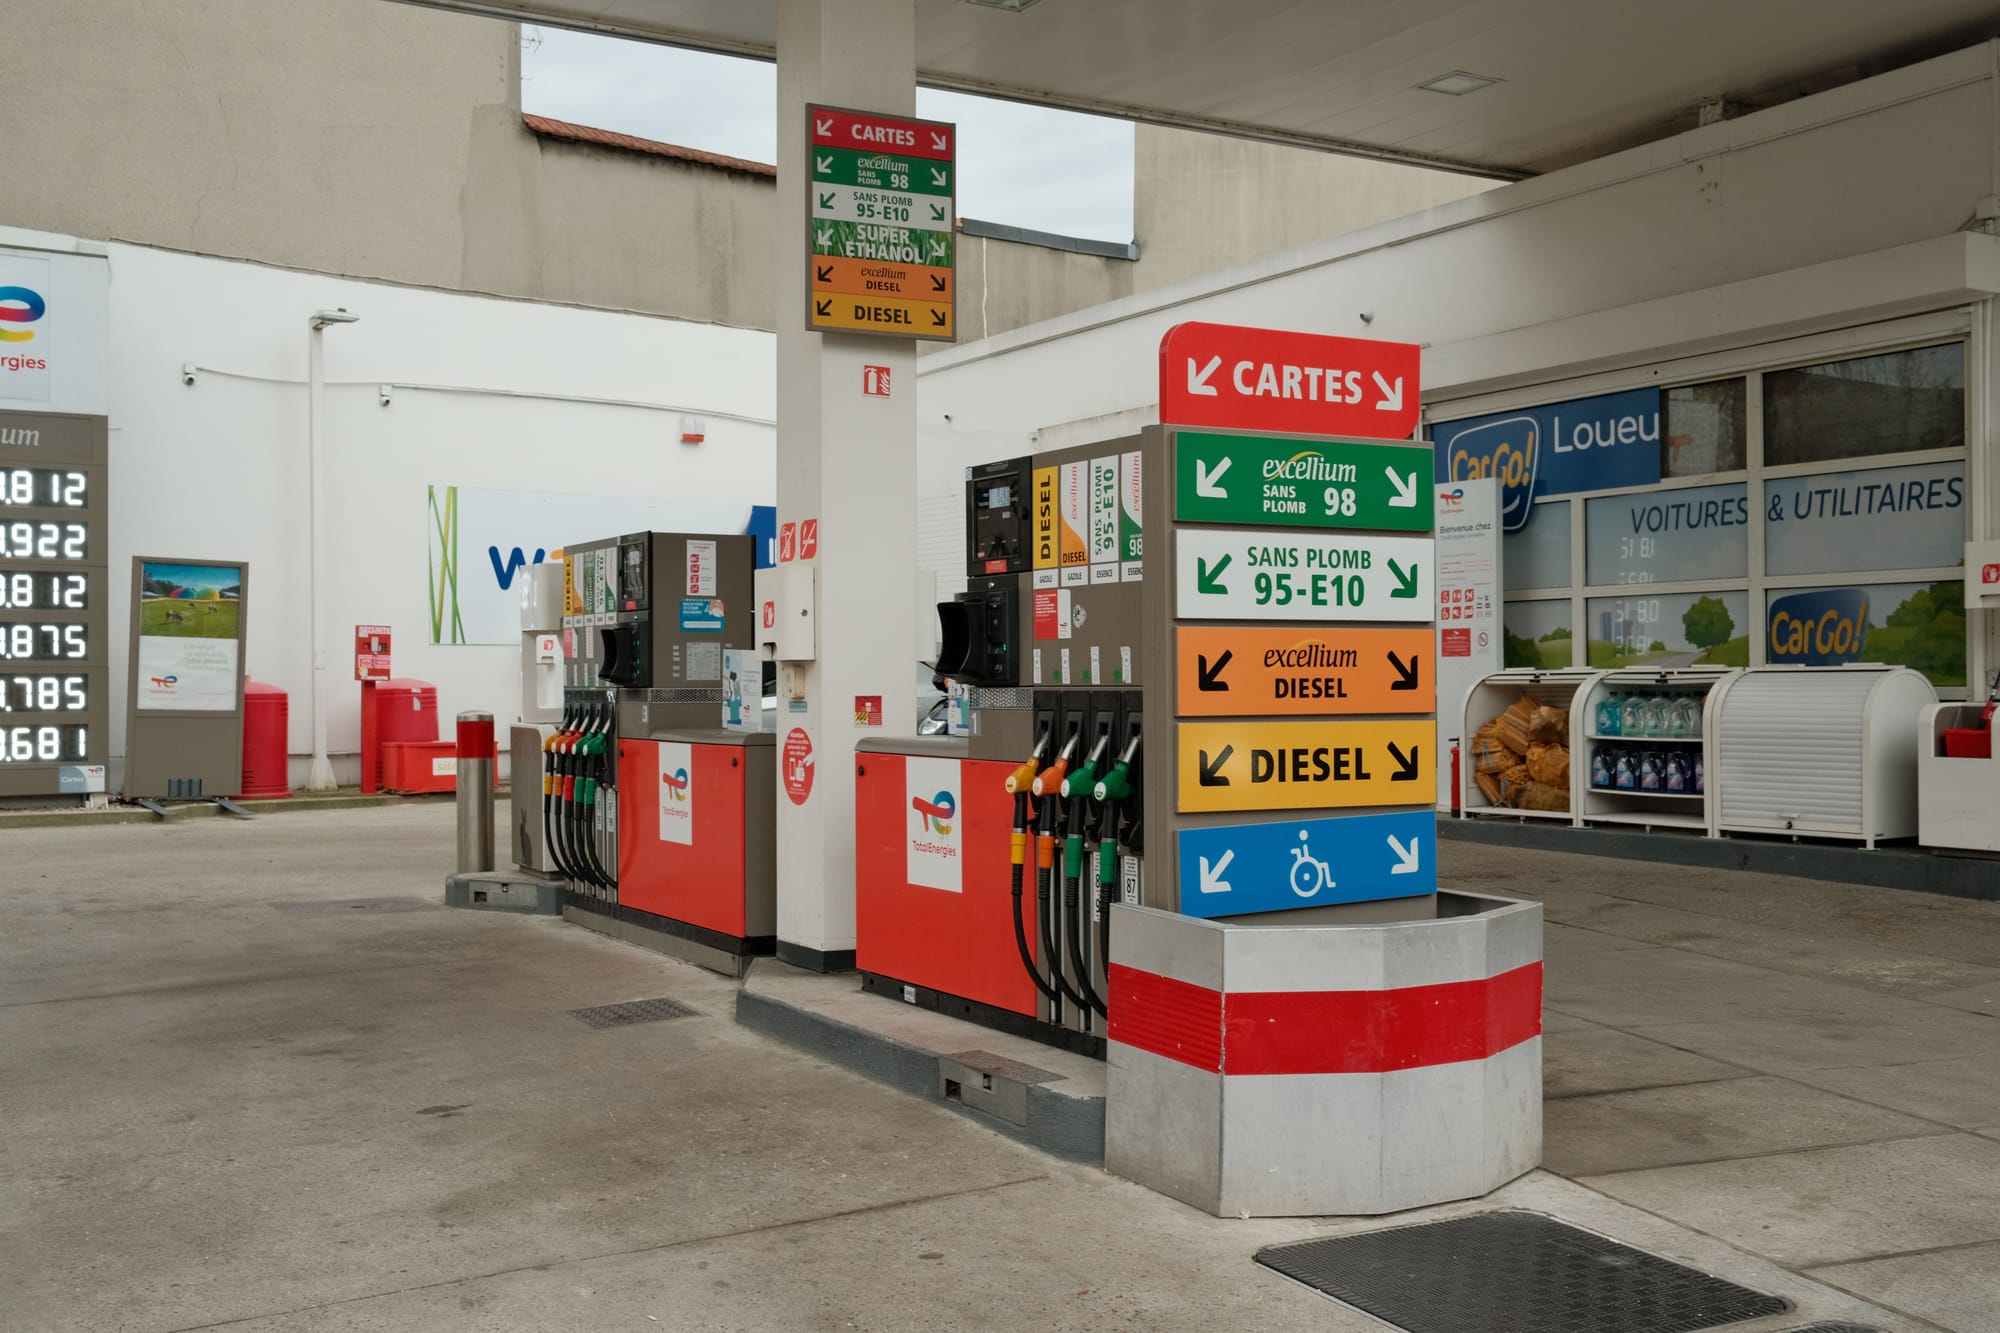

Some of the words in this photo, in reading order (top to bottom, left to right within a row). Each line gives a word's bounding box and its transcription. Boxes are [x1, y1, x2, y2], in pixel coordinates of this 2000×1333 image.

[851, 124, 915, 146] CARTES
[857, 157, 909, 173] excellium
[857, 170, 877, 179] SANS
[857, 177, 882, 186] PLOMB
[890, 174, 909, 189] 98
[853, 191, 878, 201] SANS
[881, 194, 913, 207] PLOMB
[857, 203, 909, 222] 95-E10
[857, 225, 910, 244] SUPER
[846, 242, 924, 263] ETHANOL
[861, 266, 906, 280] excellium
[866, 281, 901, 292] DIESEL
[854, 305, 912, 325] DIESEL
[1233, 360, 1363, 405] CARTES
[1554, 412, 1660, 453] Loueu
[1263, 456, 1357, 483] excellium
[1132, 455, 1140, 511] excellium
[1263, 484, 1296, 499] SANS
[1103, 468, 1114, 550] 95-E10
[1263, 500, 1306, 514] PLOMB
[1324, 487, 1357, 516] 98
[1631, 497, 1748, 534] VOITURES
[1768, 494, 1784, 522] &
[1794, 477, 1963, 519] UTILITAIRES
[1040, 475, 1051, 560] DIESEL
[1440, 525, 1474, 534] Bienvenue
[1475, 522, 1492, 531] chez
[1061, 551, 1087, 563] DIESEL
[1247, 546, 1299, 568] SANS
[1306, 549, 1372, 570] PLOMB
[1127, 567, 1143, 576] ESSENC
[0, 574, 86, 608] .812
[1255, 572, 1365, 607] 95-E10
[1771, 602, 1867, 656] CarGo!
[1264, 645, 1357, 668] excellium
[1275, 677, 1348, 699] DIESEL
[643, 705, 648, 722] 3
[971, 712, 977, 734] 1
[0, 727, 86, 762] .681
[1251, 747, 1371, 783] DIESEL
[912, 840, 957, 858] TotalEnergies
[1126, 878, 1136, 895] 87
